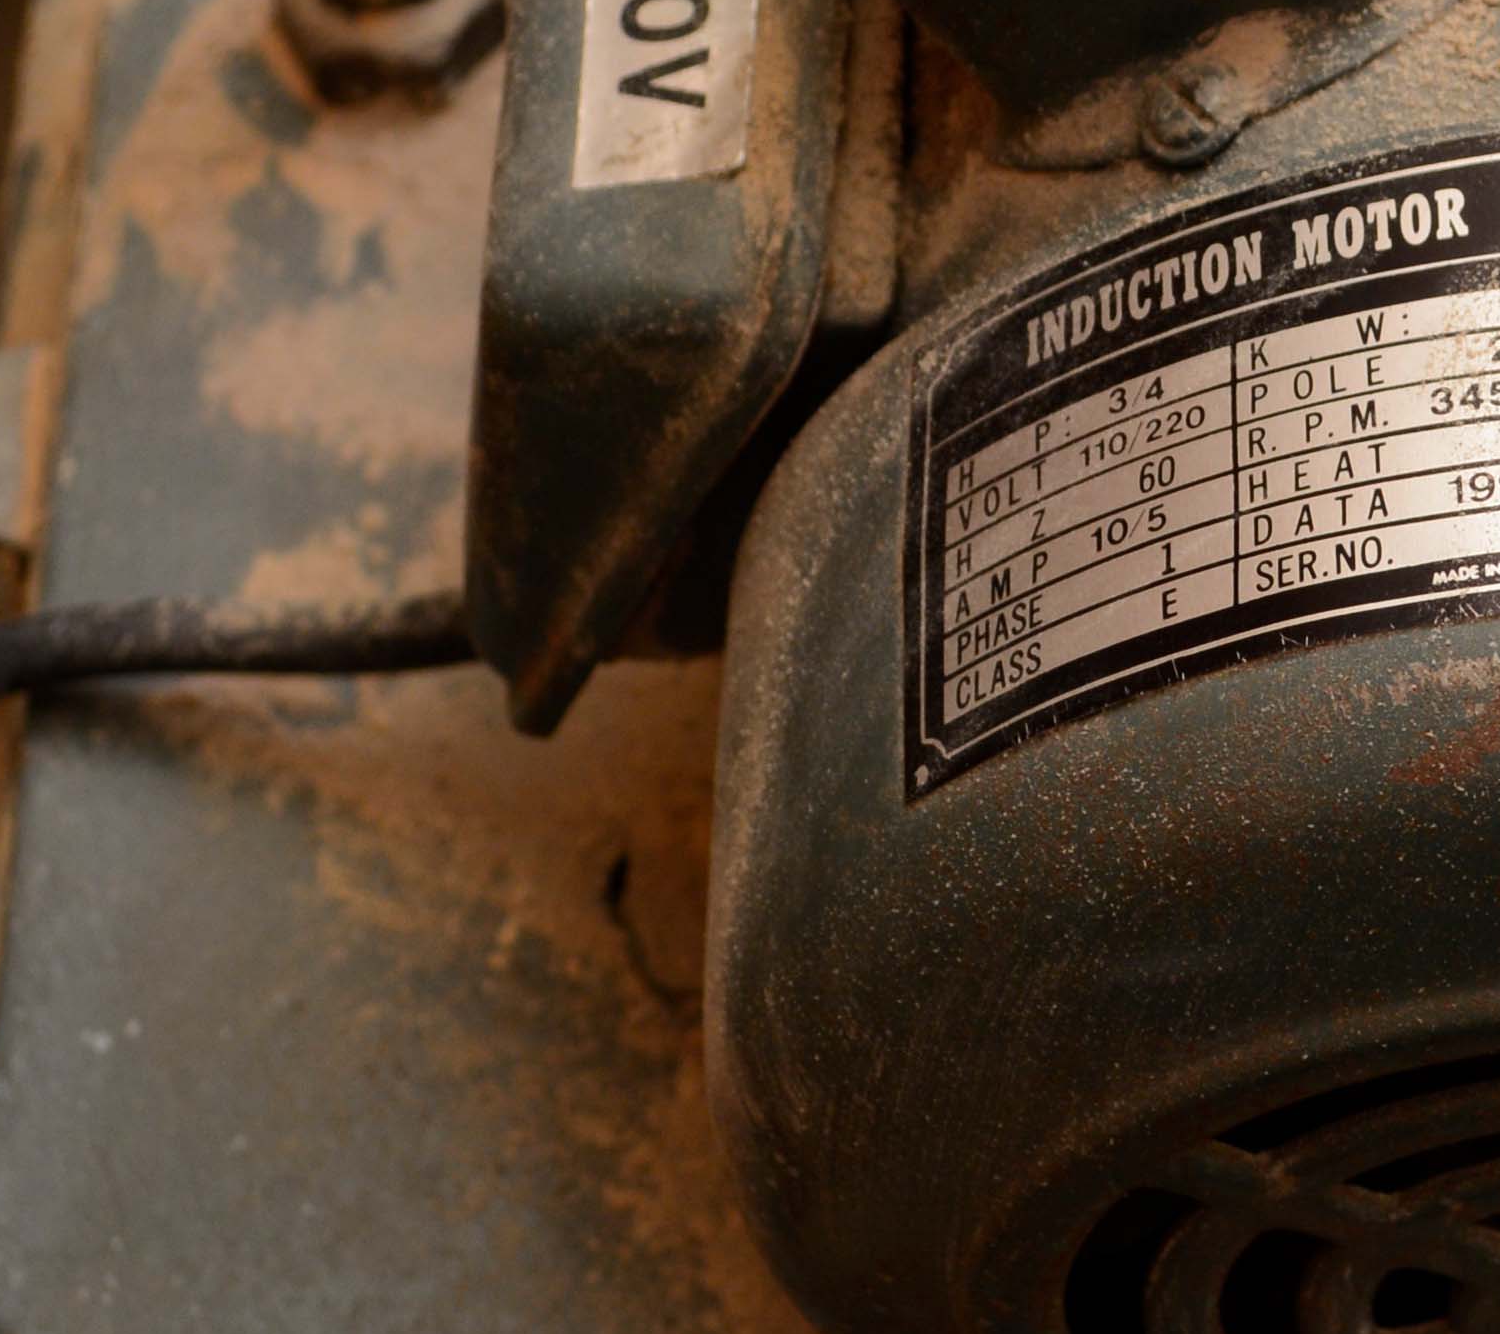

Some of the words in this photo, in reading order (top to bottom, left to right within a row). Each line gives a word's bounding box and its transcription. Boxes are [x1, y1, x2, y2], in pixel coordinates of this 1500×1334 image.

[1026, 230, 1263, 368] INDUCTION
[1292, 187, 1469, 270] MOTOR
[1107, 376, 1165, 414] 3/4
[958, 462, 1046, 530] VOLT
[1079, 405, 1206, 467] 110/220
[1138, 454, 1176, 494] 60
[1090, 503, 1168, 553] 10/5
[956, 593, 1044, 666] PHASE
[1160, 542, 1176, 576] 1
[1432, 565, 1480, 586] MADE
[955, 642, 1042, 710] CLASS
[1161, 587, 1179, 621] E
